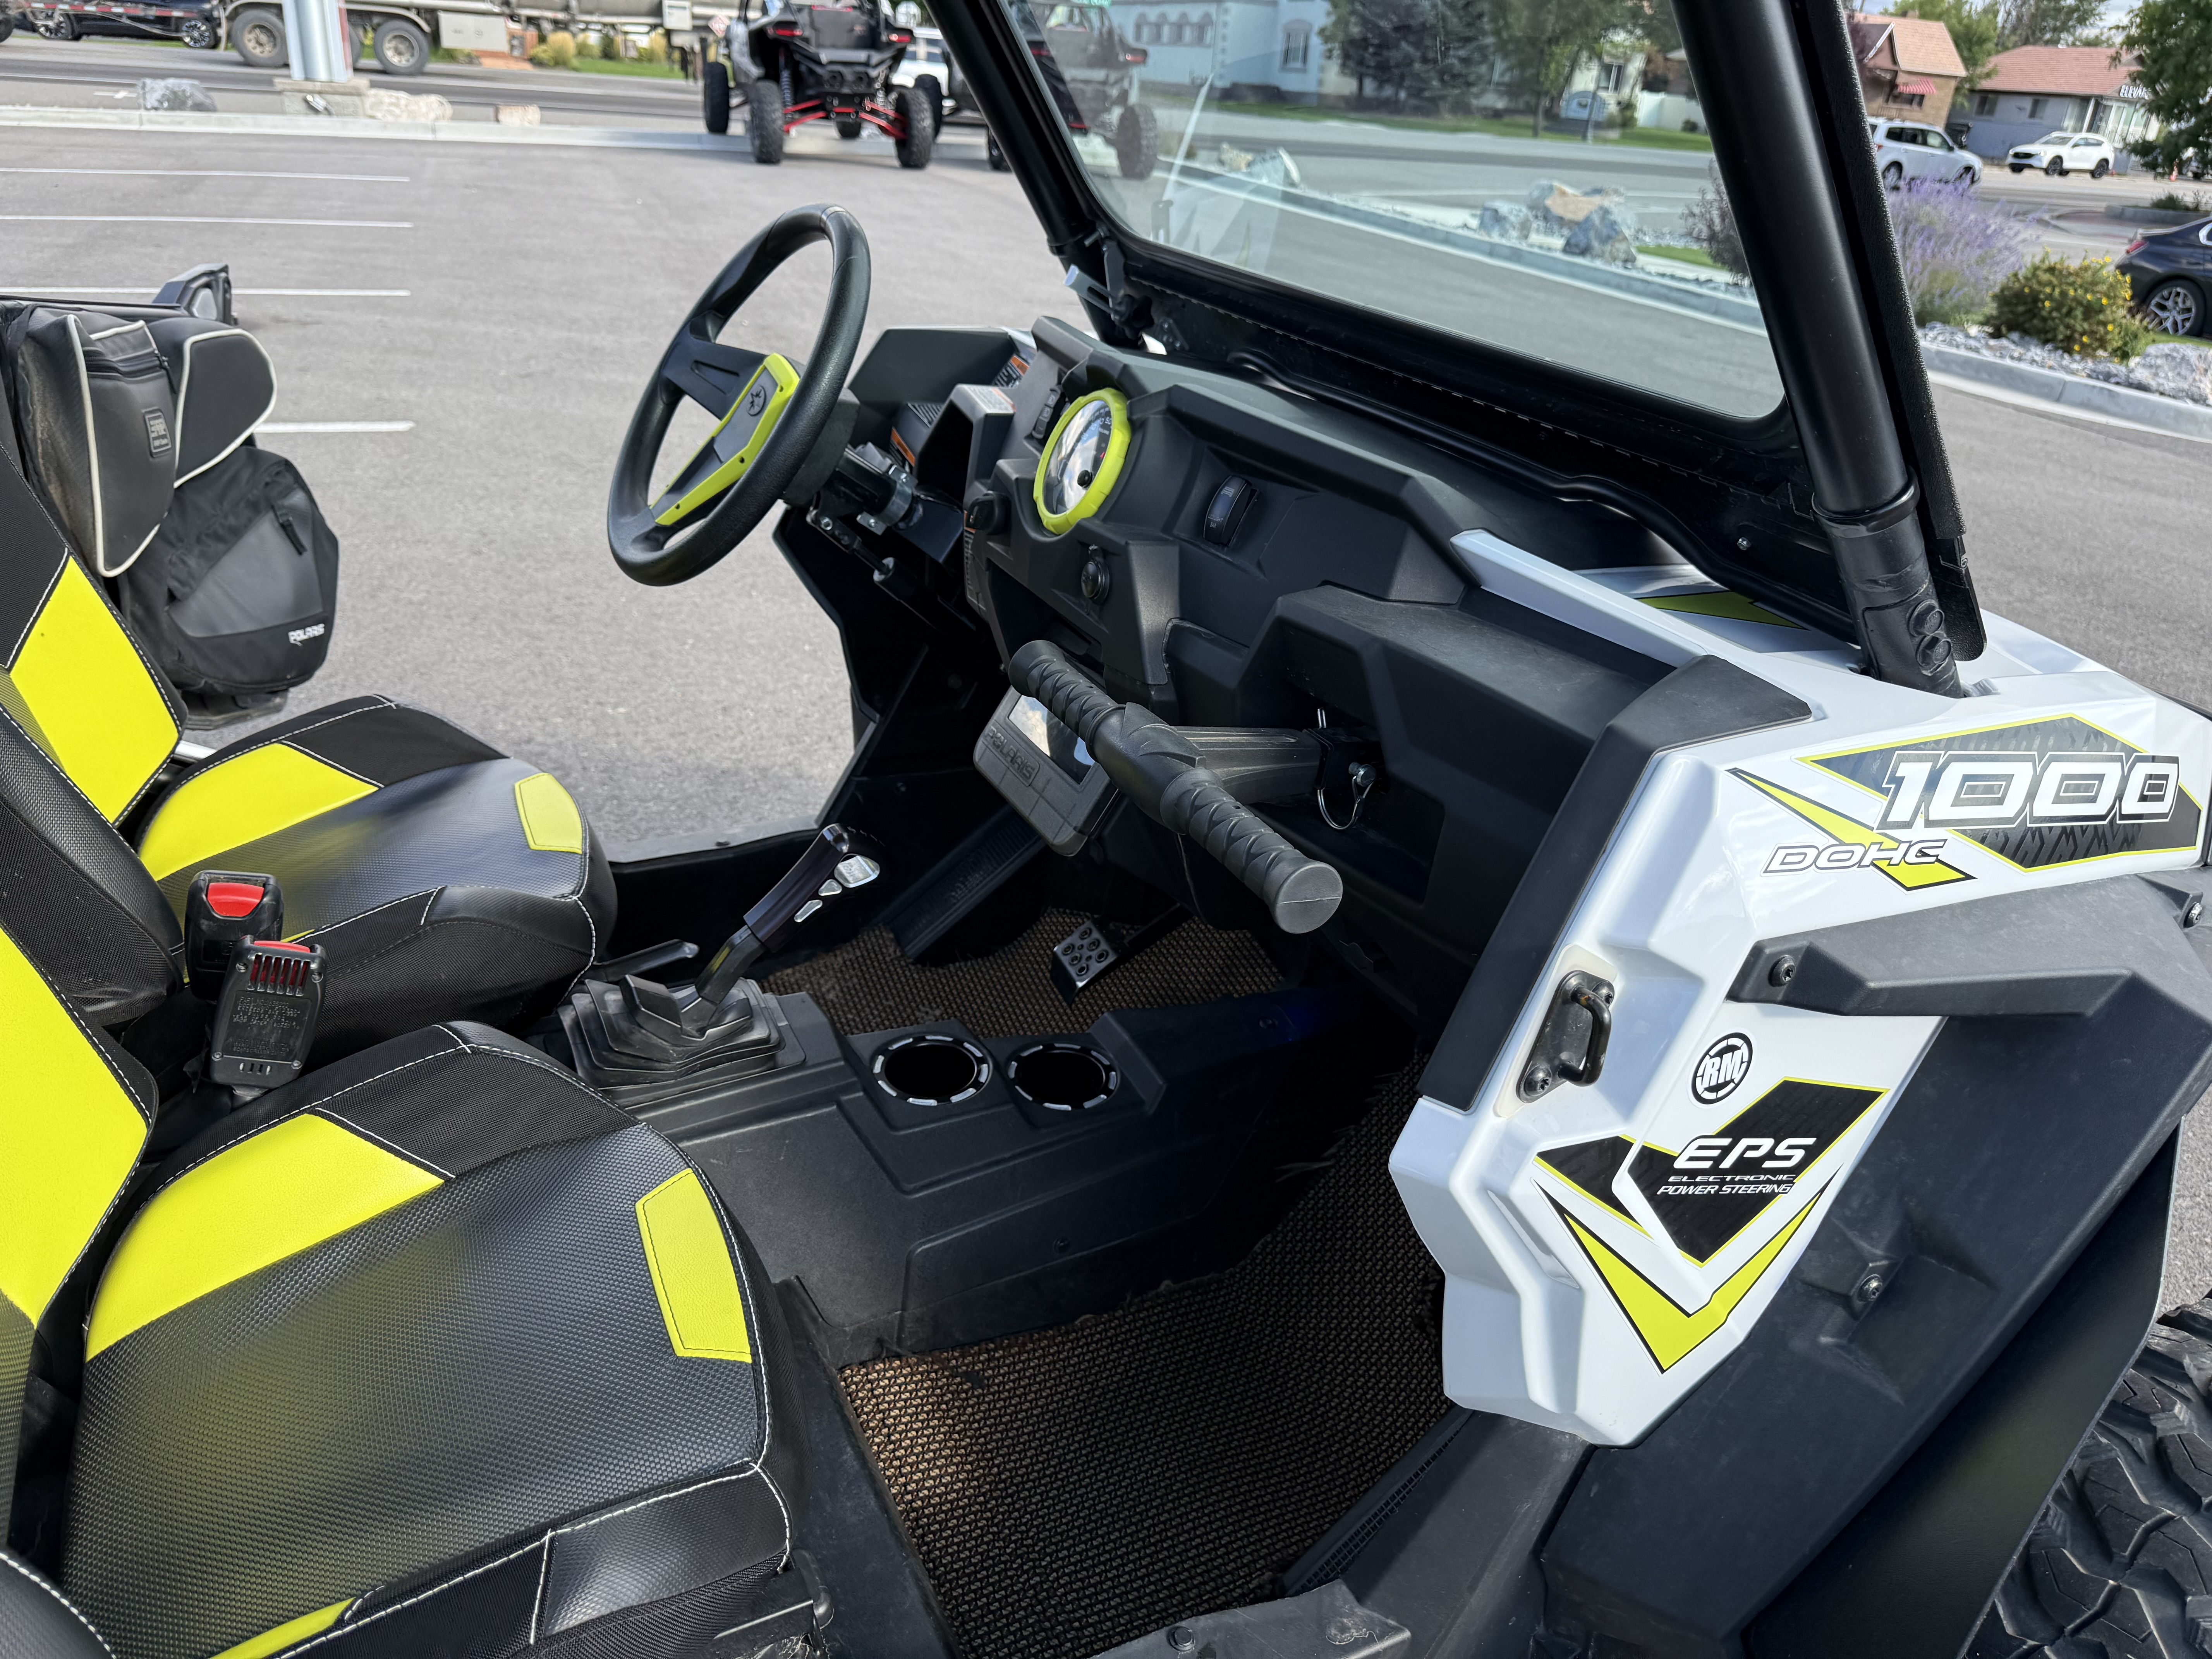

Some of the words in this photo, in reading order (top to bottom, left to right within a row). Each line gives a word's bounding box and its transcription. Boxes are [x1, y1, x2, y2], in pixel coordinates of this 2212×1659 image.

[288, 623, 325, 646] POLARIS
[985, 725, 1036, 780] POLARIS
[1876, 752, 2180, 830] 1000
[1764, 840, 1945, 874] DOHC
[1702, 1049, 1743, 1088] RM
[1673, 1137, 1817, 1169] EPS
[1657, 1185, 1719, 1195] POWER
[1719, 1183, 1795, 1194] STEERING
